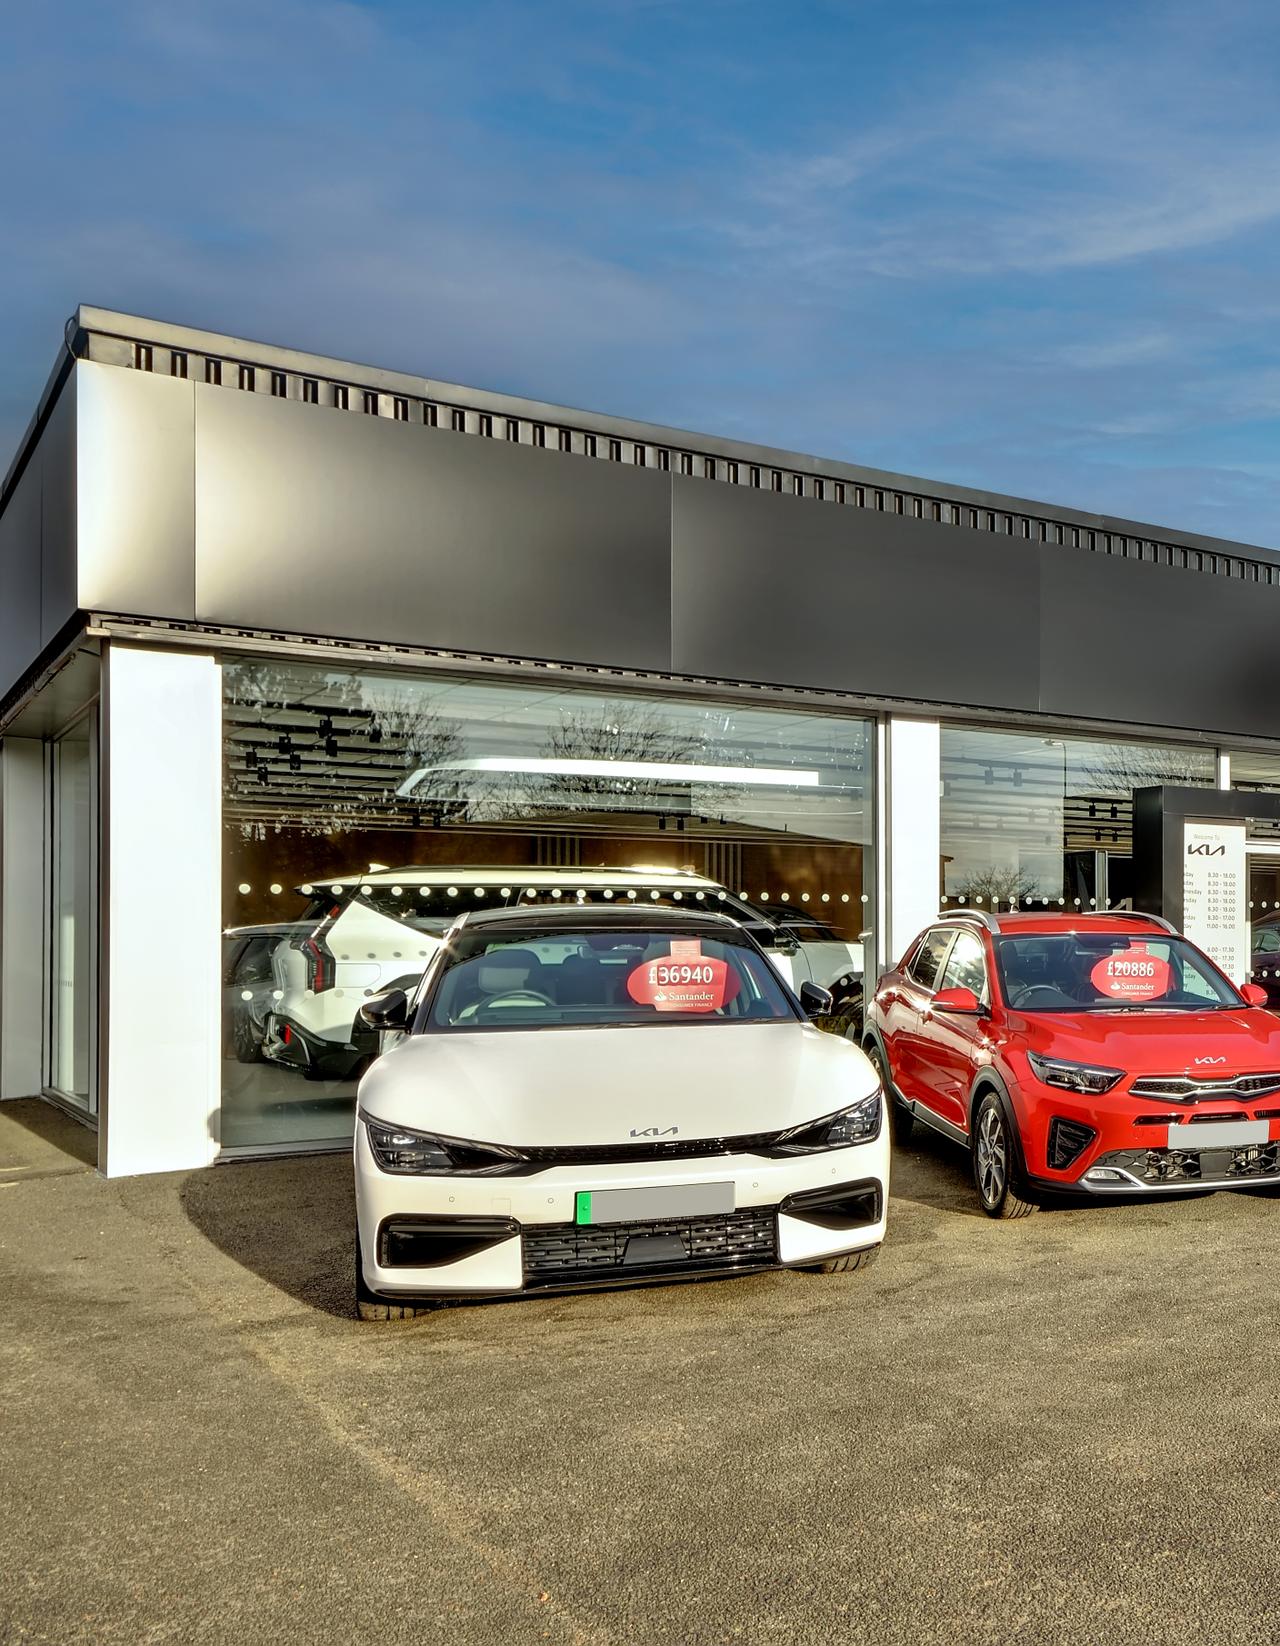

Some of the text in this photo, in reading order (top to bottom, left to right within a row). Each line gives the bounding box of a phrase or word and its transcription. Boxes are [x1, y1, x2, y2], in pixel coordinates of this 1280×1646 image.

[1187, 843, 1226, 857] KIA
[648, 965, 714, 985] £36940
[1107, 961, 1154, 977] £20886
[1121, 982, 1155, 991] Santander
[668, 991, 714, 1001] Santander
[1194, 1056, 1226, 1065] KIA
[630, 1126, 679, 1138] KIA
